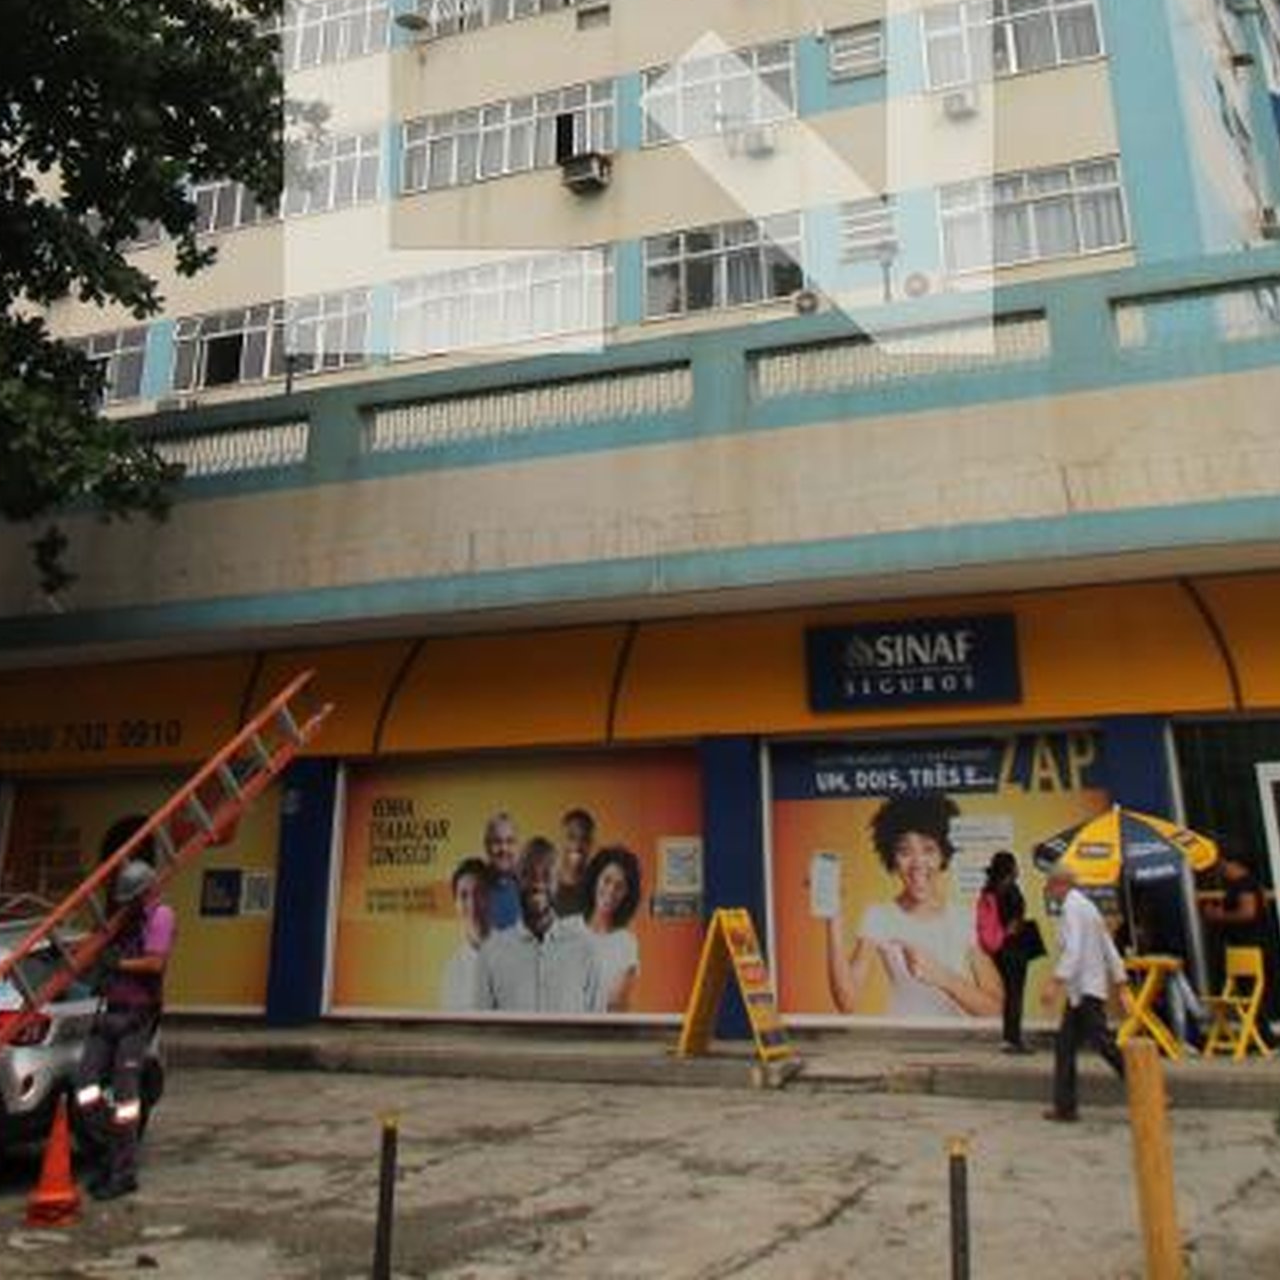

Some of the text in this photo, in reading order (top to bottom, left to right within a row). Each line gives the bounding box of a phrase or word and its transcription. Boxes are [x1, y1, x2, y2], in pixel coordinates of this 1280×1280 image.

[875, 630, 974, 668] SINAF
[844, 672, 975, 697] SEGUROS
[908, 761, 960, 788] TRÊS
[997, 730, 1096, 795] ZAP
[369, 818, 451, 844] TRABALHAR
